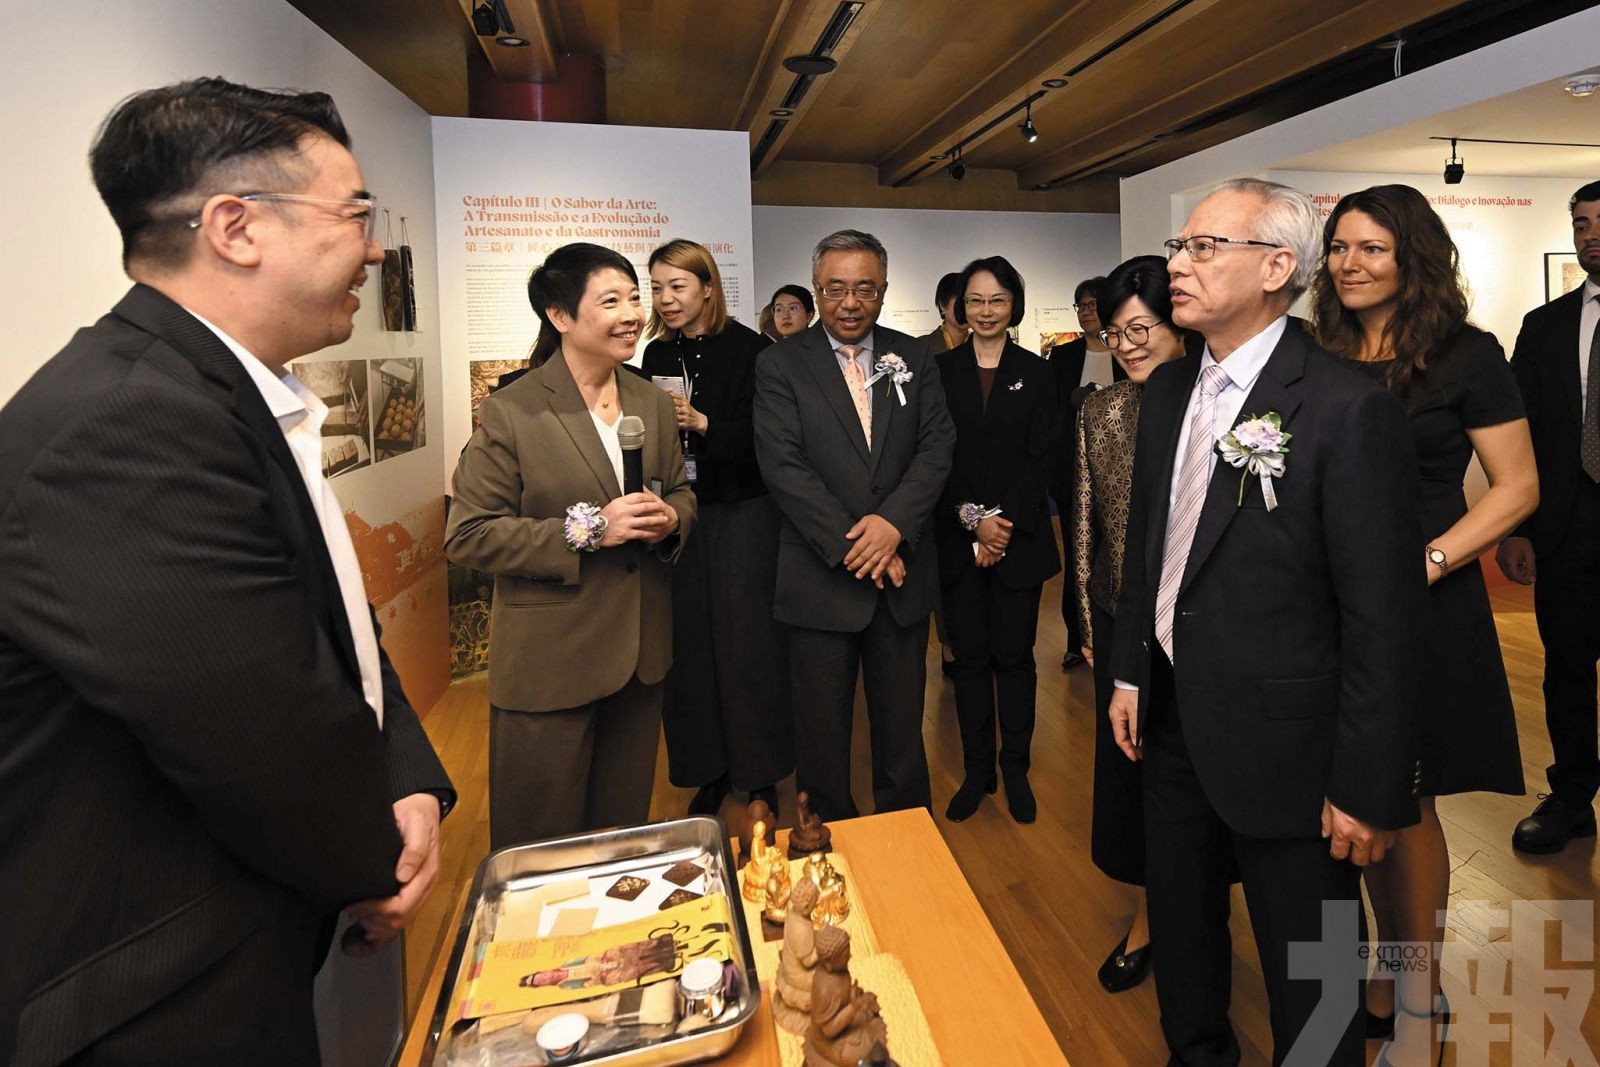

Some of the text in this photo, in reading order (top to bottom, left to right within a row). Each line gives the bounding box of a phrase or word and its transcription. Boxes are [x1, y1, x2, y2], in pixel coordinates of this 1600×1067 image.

[463, 195, 522, 210] Capítulo
[525, 197, 540, 208] III
[551, 197, 562, 208] O
[564, 197, 604, 209] Sabor
[607, 198, 623, 209] da
[625, 199, 657, 210] Arte:
[1437, 195, 1471, 208] Diálogo
[1472, 198, 1478, 206] e
[1478, 196, 1516, 208] Inovação
[1517, 198, 1532, 206] nas
[464, 210, 670, 226] A Transmissão e a Evolução do
[464, 225, 661, 238] Artesanato e da Gastronomia
